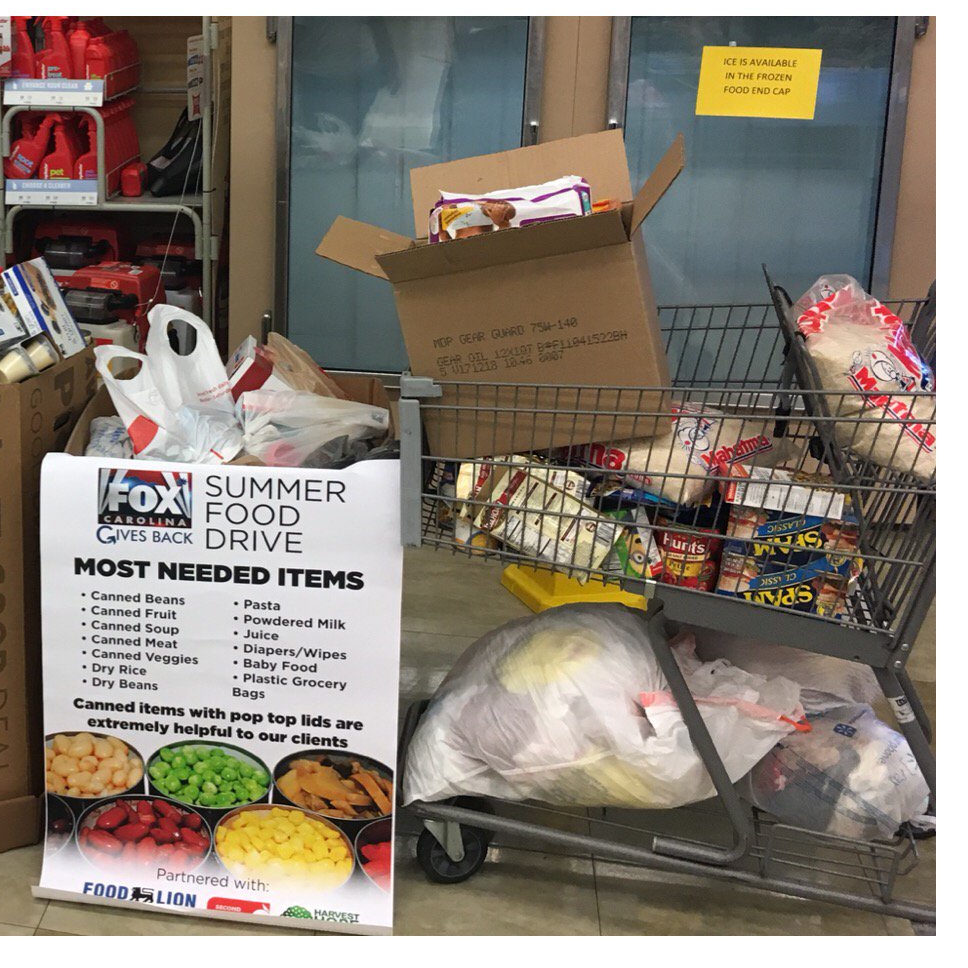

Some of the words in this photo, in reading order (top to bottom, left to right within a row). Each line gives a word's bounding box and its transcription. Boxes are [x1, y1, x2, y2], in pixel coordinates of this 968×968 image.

[749, 59, 797, 67] AVAILABLE
[738, 72, 753, 80] THE
[757, 73, 792, 81] FROZEN
[724, 86, 749, 94] FOOD
[459, 332, 485, 345] GEAR
[491, 325, 525, 340] GUARD
[436, 354, 463, 366] GEAR
[206, 475, 345, 502] SUMMER
[108, 482, 182, 515] FOX
[103, 515, 186, 526] CAROLINA
[207, 502, 300, 526] FOOD
[96, 525, 147, 544] GIVES
[153, 531, 193, 544] BACK
[206, 528, 302, 553] DRIVE
[75, 558, 150, 578] MOST
[158, 562, 270, 584] NEEDED
[278, 568, 364, 590] ITEMS
